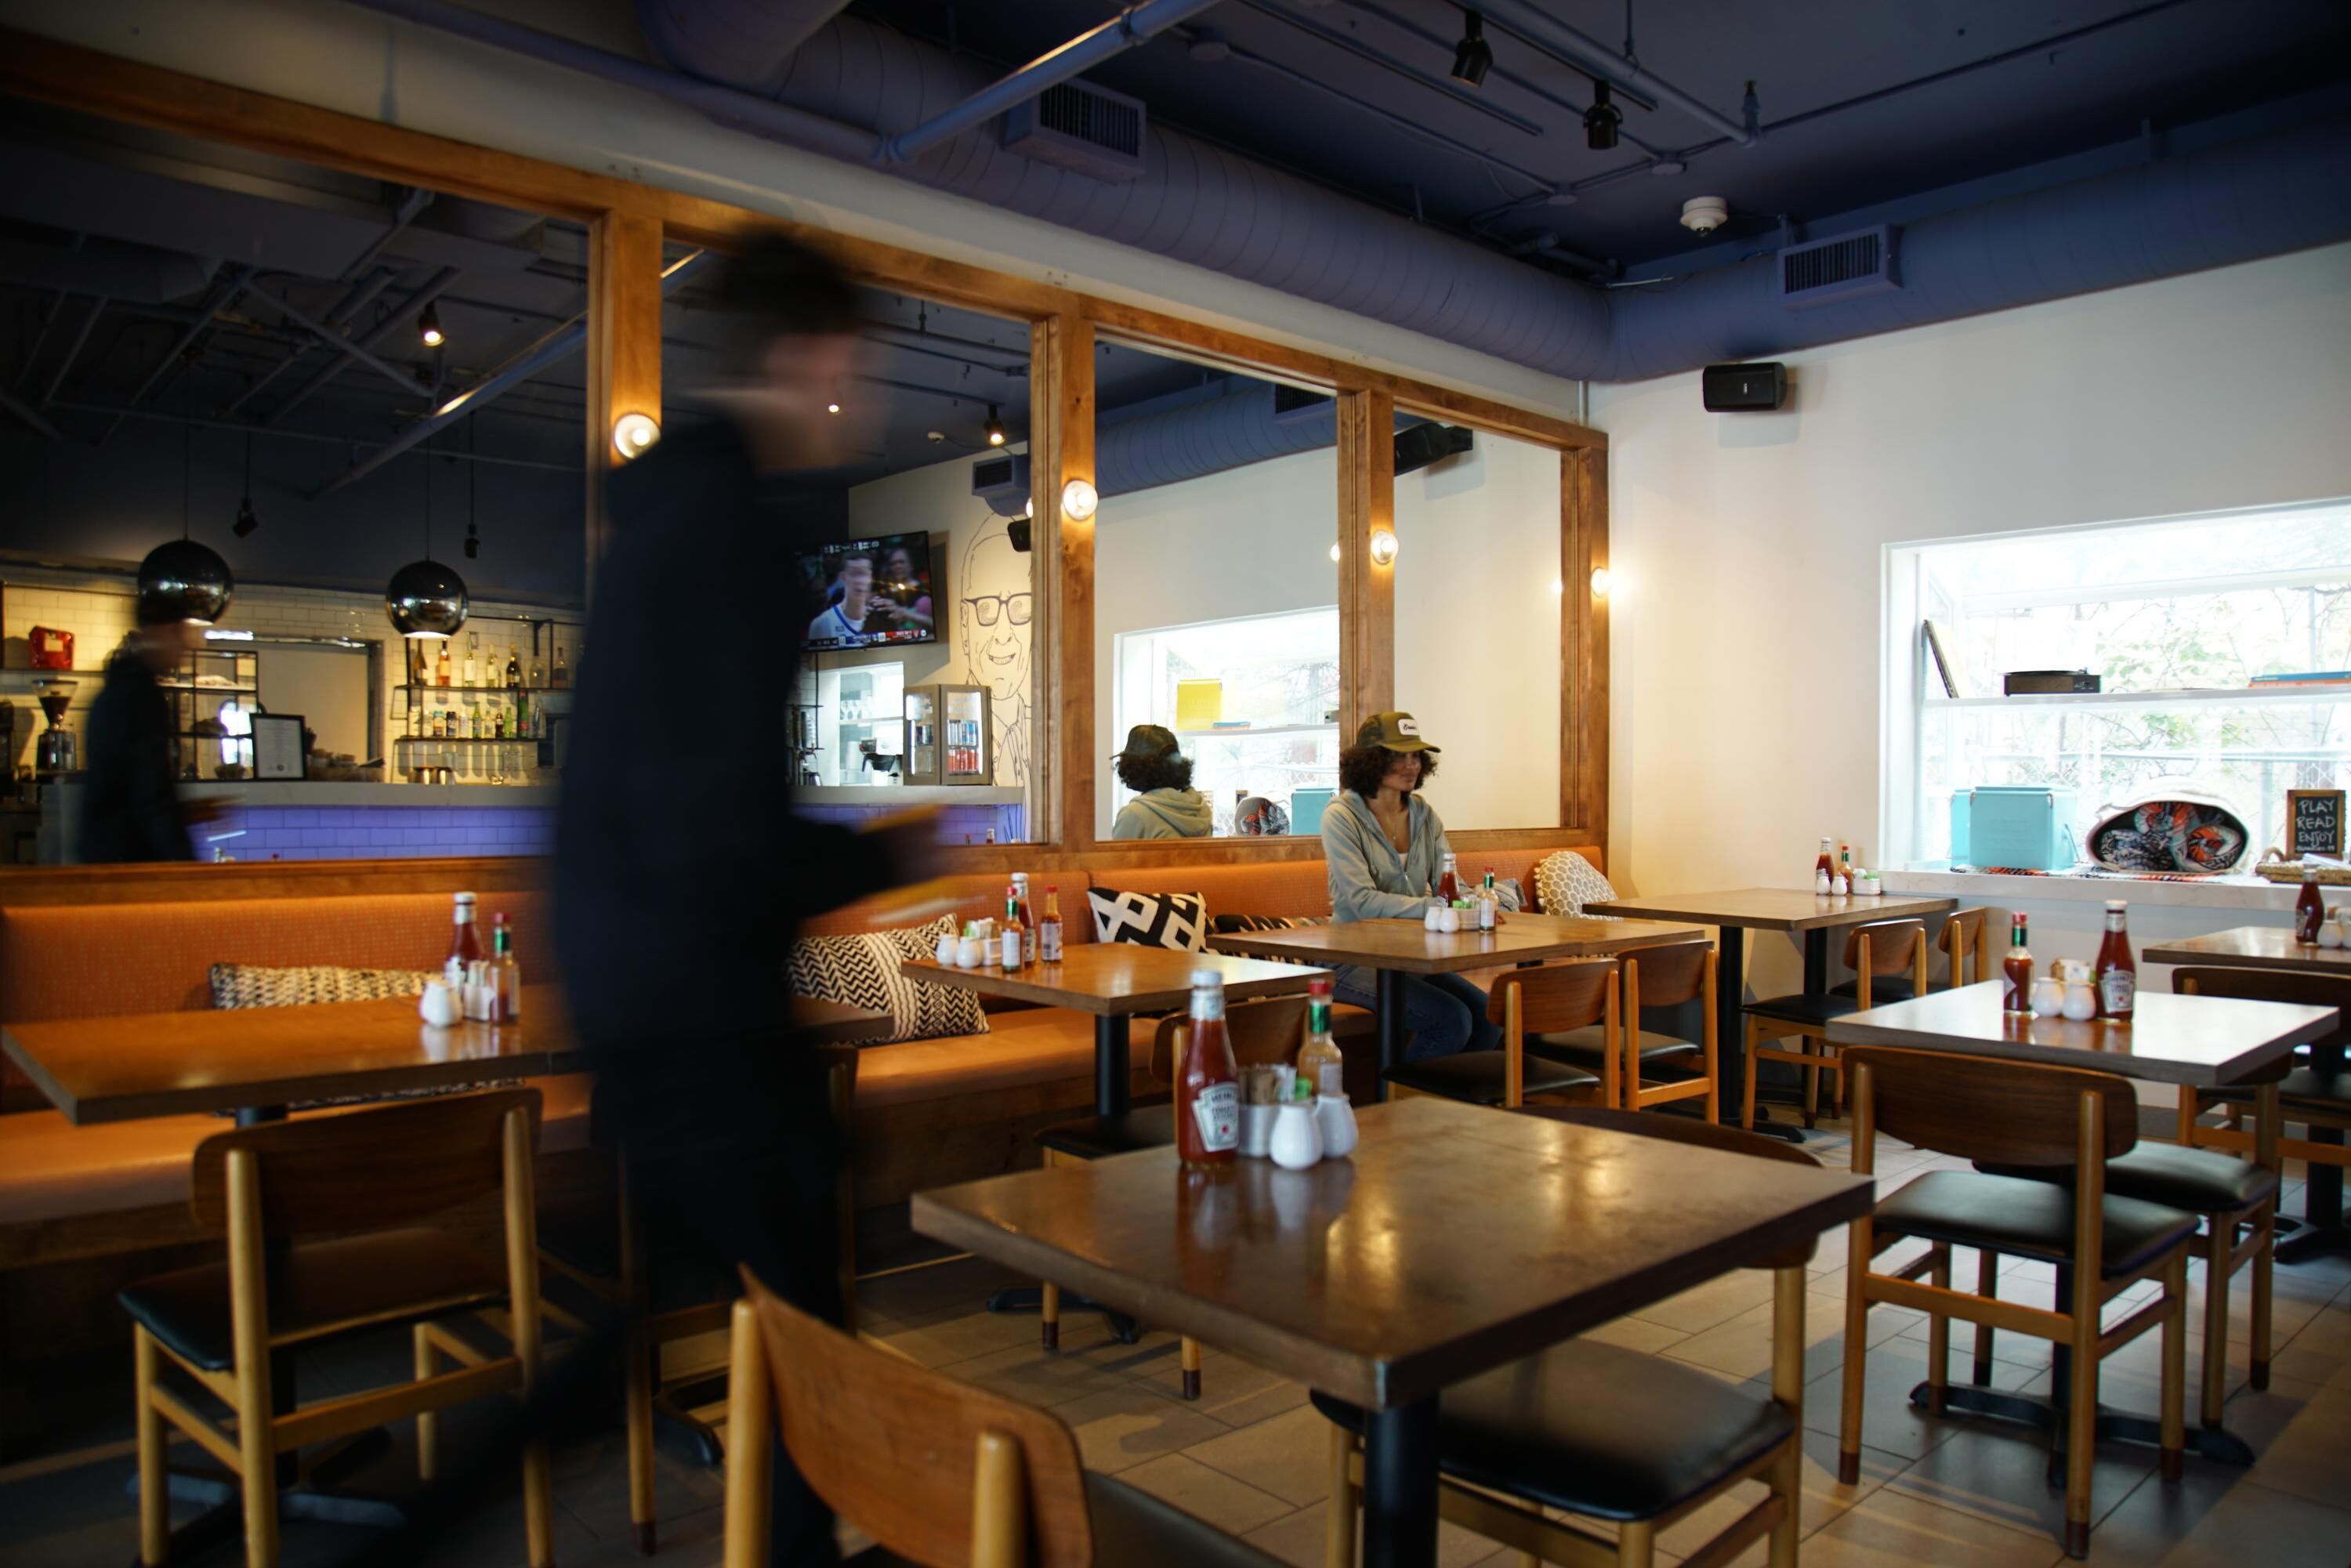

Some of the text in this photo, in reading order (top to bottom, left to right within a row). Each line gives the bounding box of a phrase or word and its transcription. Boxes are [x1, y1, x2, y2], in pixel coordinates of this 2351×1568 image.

[2298, 800, 2335, 815] PLAY
[2296, 816, 2335, 830] READ
[2298, 831, 2335, 846] ENJOY
